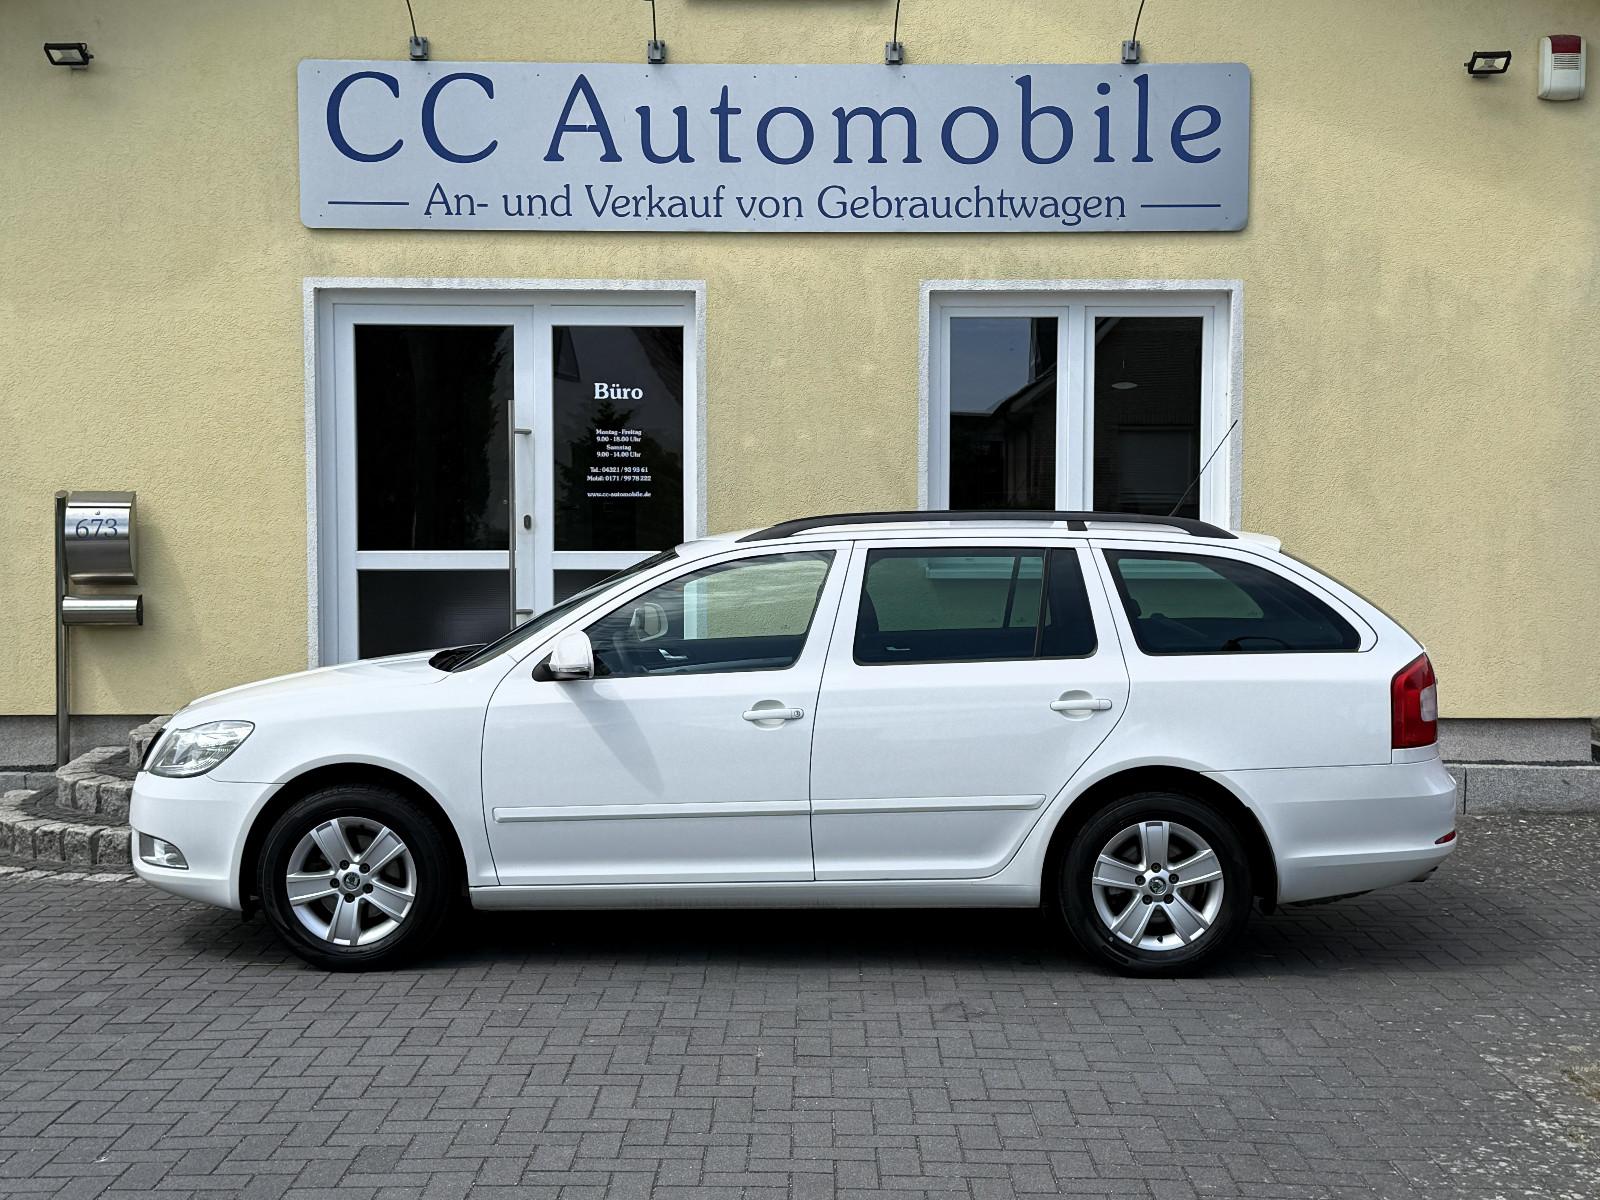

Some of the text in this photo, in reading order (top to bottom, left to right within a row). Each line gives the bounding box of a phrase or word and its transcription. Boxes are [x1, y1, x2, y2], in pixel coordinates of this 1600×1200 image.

[327, 71, 1222, 165] CC Automobile
[424, 183, 1126, 227] An- und Verkauf von Gebrauchtwagen
[593, 382, 644, 400] Büro
[595, 428, 618, 436] Montag
[621, 428, 642, 437] Freitag
[75, 518, 118, 539] 673
